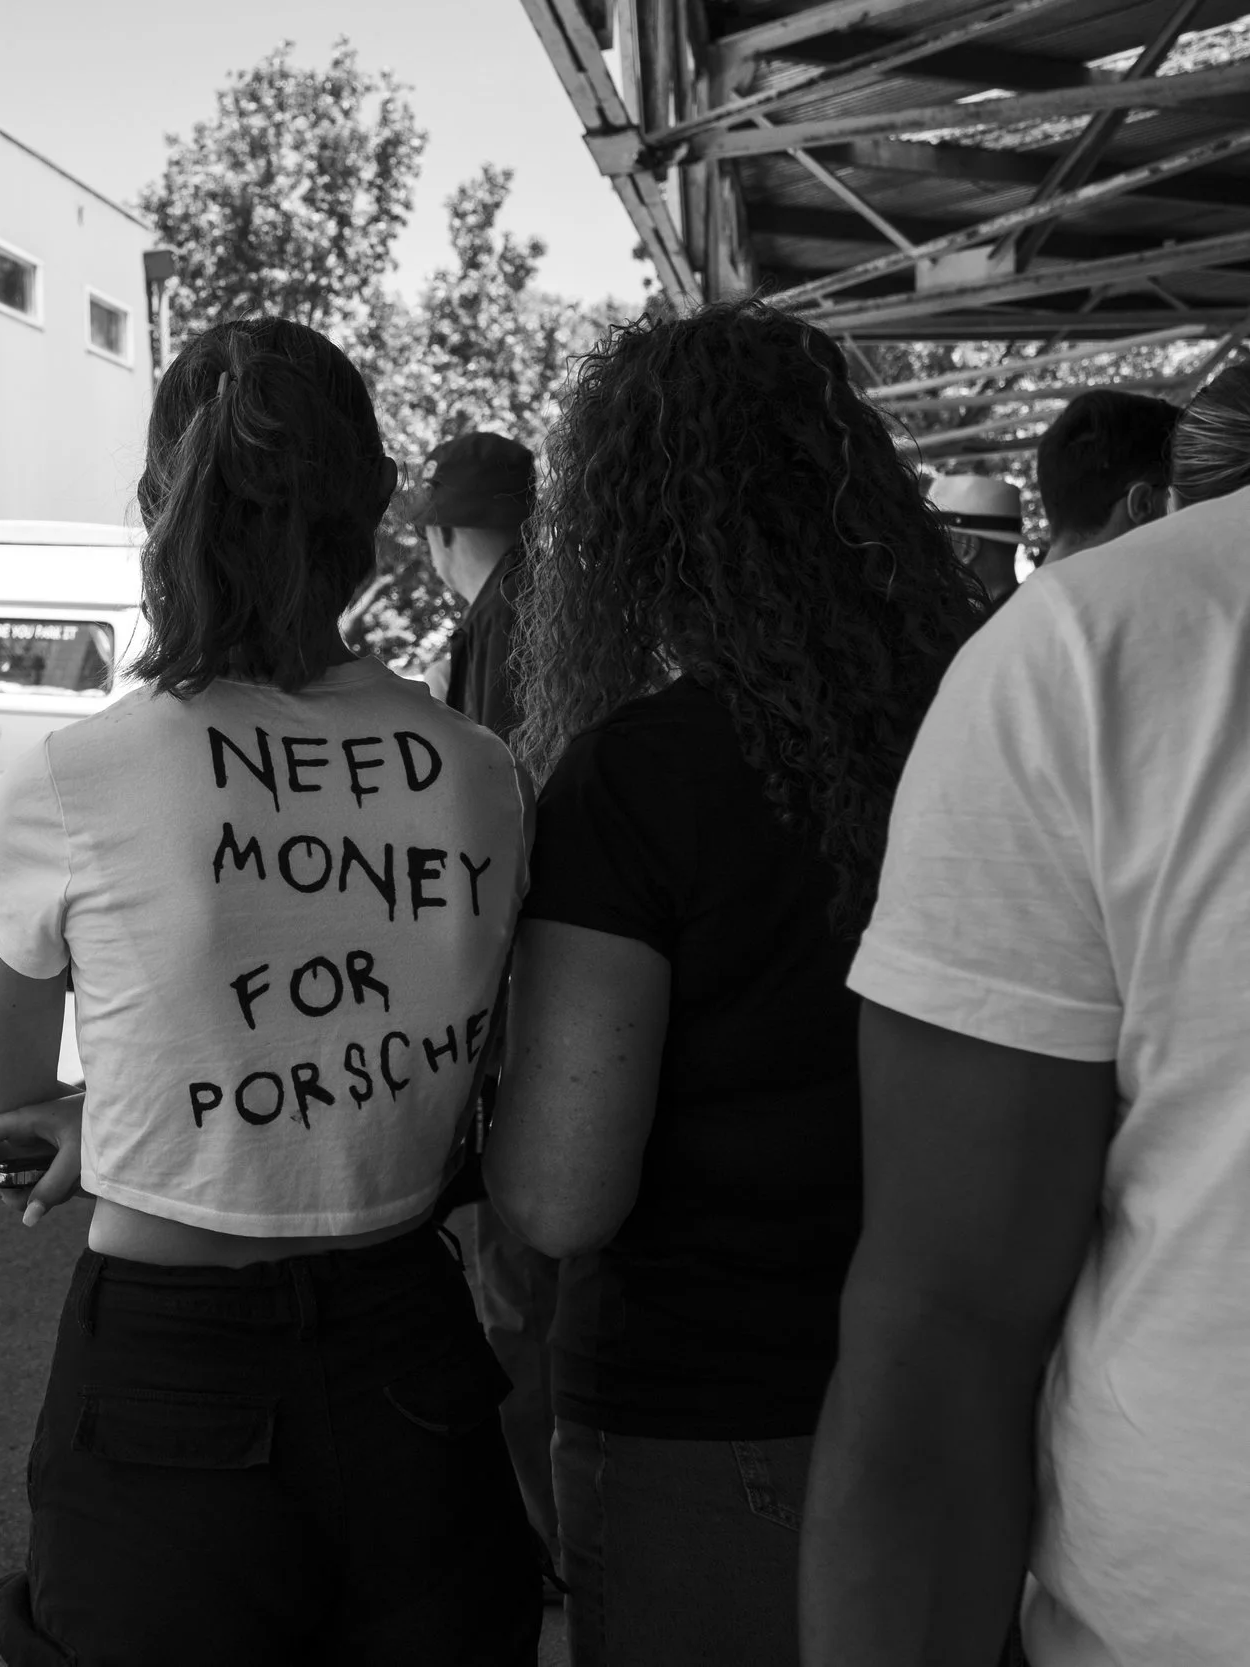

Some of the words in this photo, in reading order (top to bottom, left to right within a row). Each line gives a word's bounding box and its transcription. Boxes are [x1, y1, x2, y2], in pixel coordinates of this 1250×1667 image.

[208, 726, 442, 812] NEED
[213, 822, 491, 922] MONEY
[230, 950, 390, 1030] FOR
[189, 1008, 489, 1130] PORSCHE
